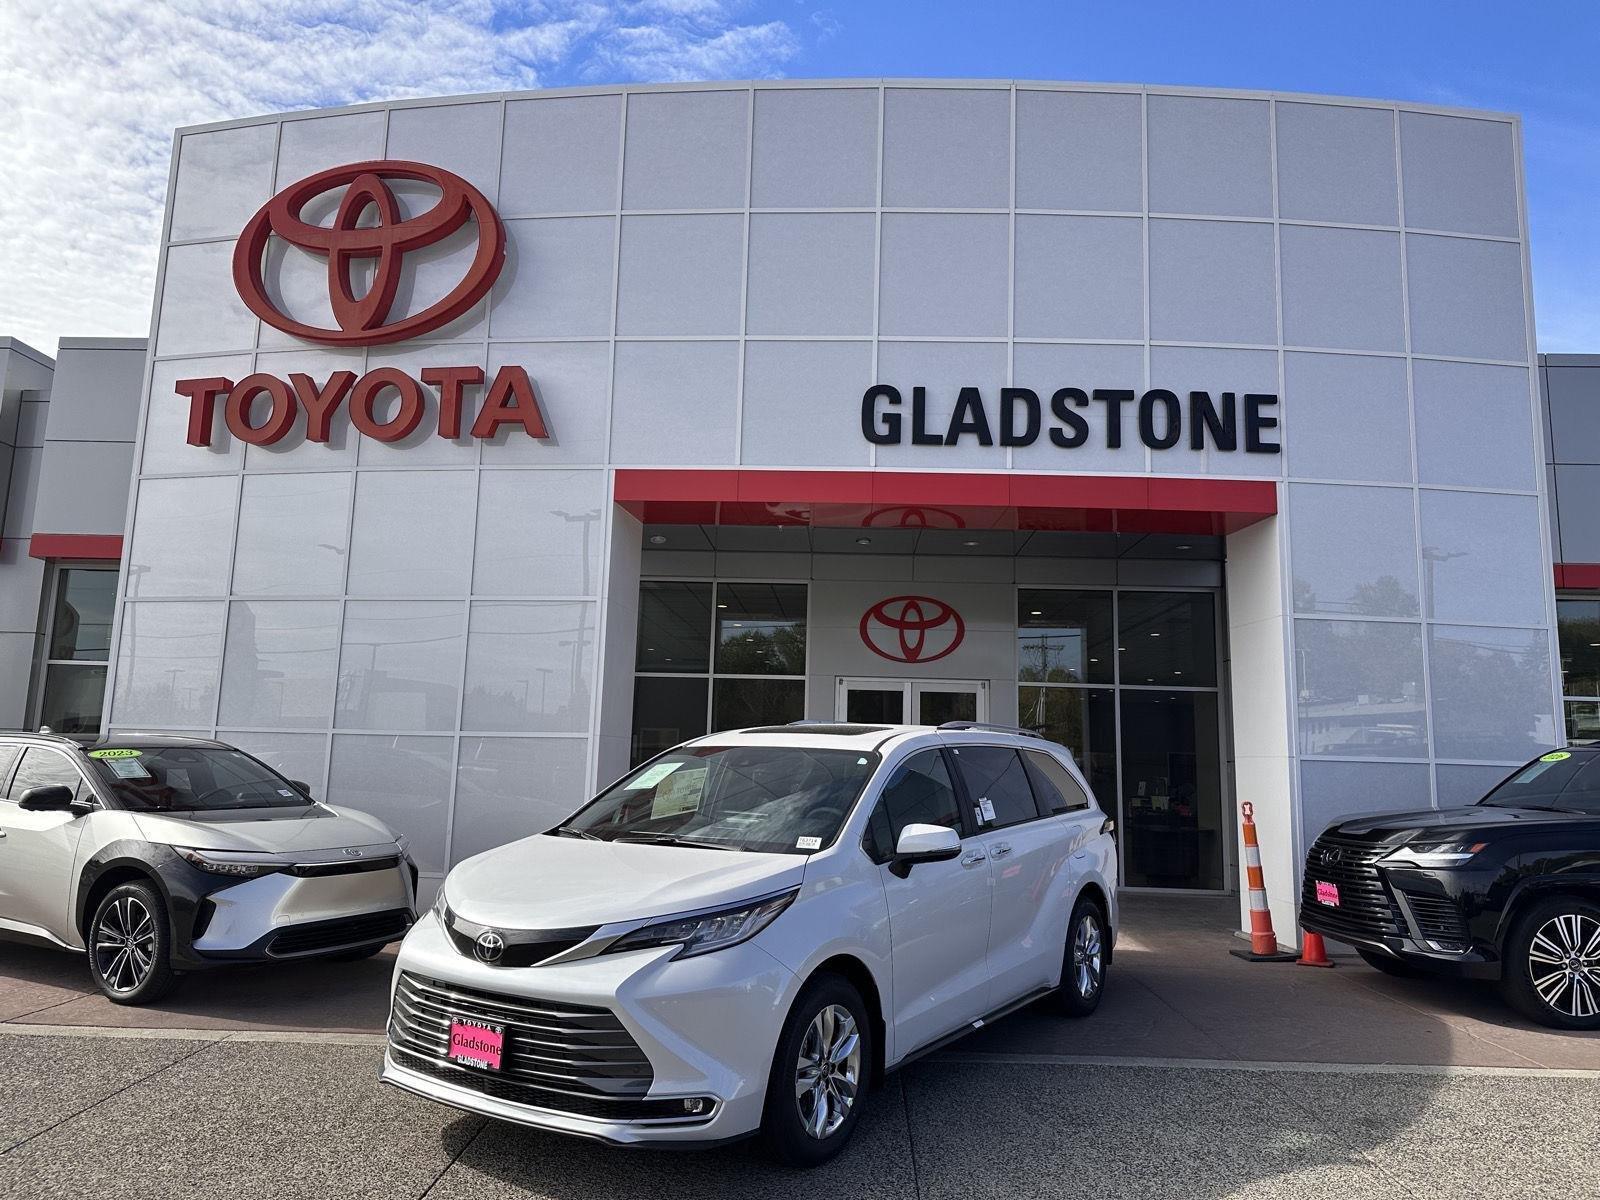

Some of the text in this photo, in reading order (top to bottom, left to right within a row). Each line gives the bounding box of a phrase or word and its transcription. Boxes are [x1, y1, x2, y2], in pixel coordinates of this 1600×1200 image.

[175, 365, 550, 448] TOYOTA
[861, 384, 1281, 454] GLADSTONE
[99, 750, 133, 758] 2023
[462, 1018, 491, 1031] TOYOTA
[452, 1033, 502, 1056] Gladstone
[456, 1055, 488, 1070] GLADSTONE
